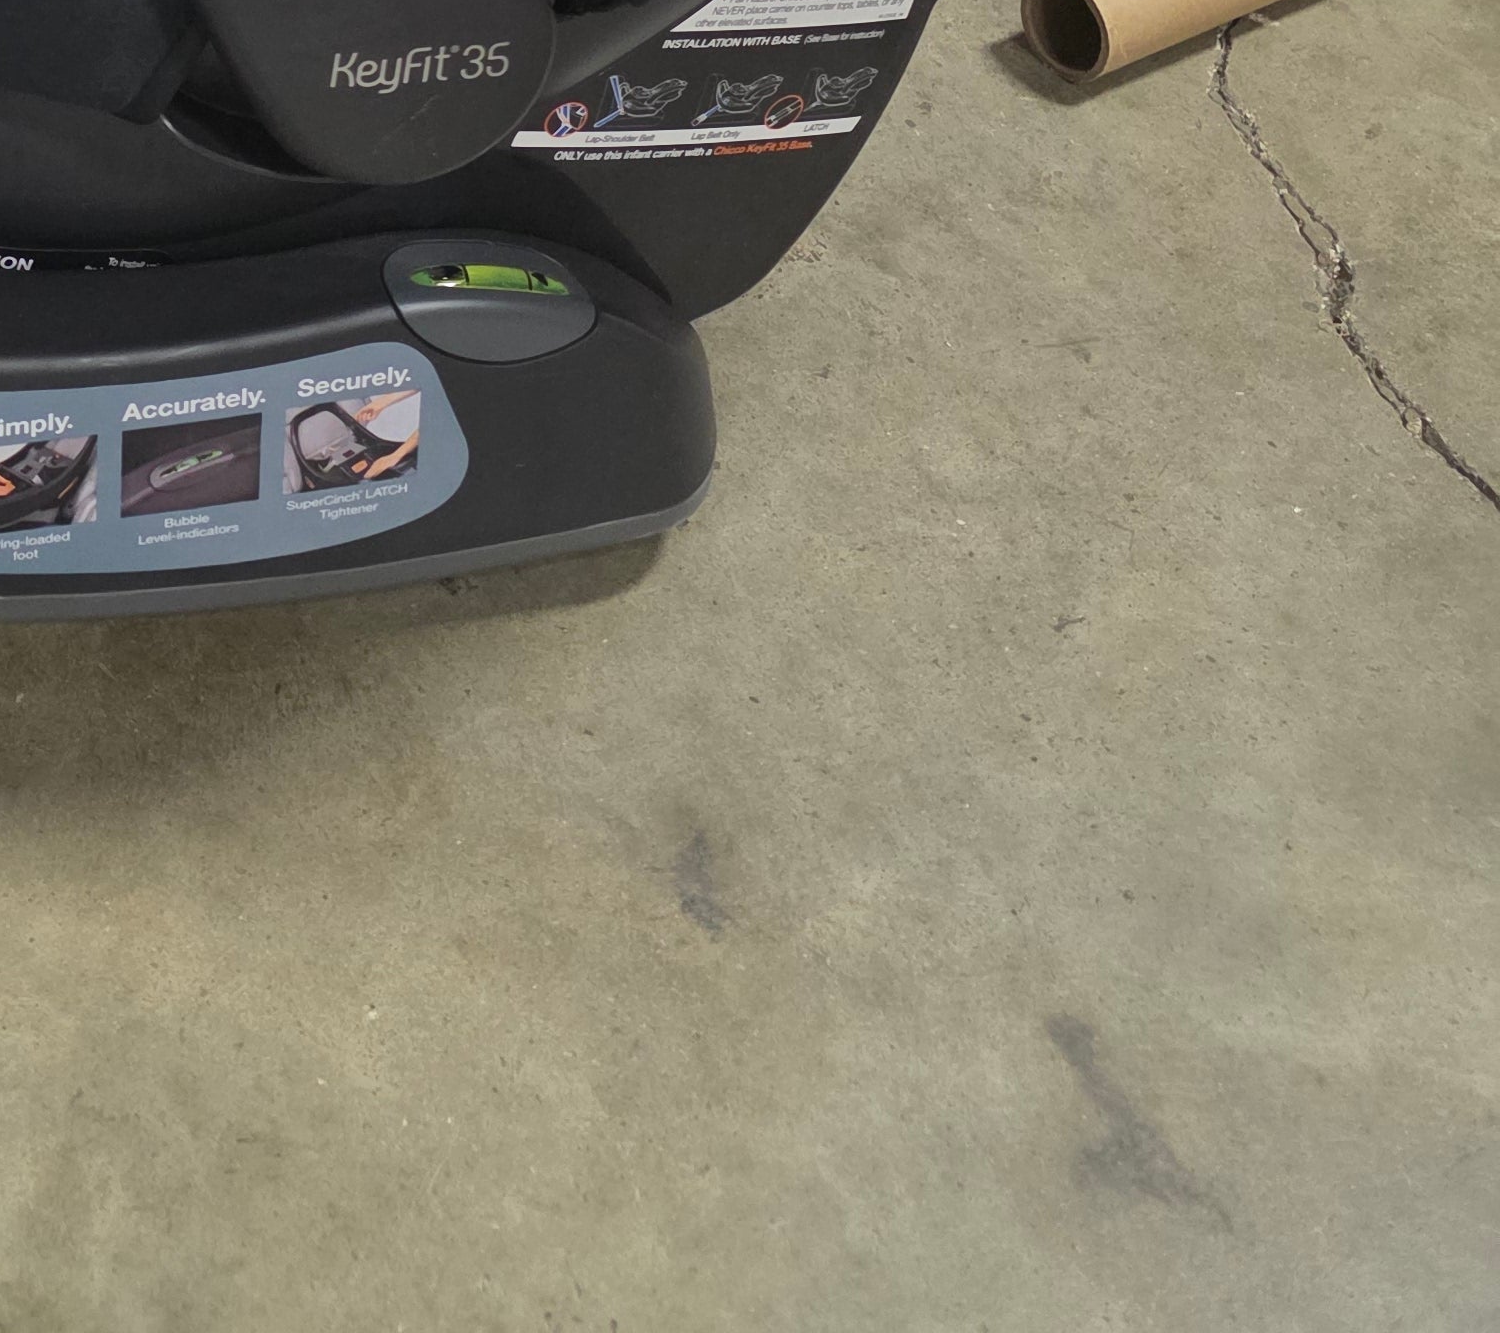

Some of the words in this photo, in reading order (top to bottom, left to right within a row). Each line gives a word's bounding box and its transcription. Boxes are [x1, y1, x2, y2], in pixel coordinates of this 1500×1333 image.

[712, 6, 745, 15] NEVER
[745, 5, 767, 16] place
[662, 37, 741, 49] INSTALLATION
[742, 35, 769, 47] WITH
[771, 34, 801, 45] BASE
[329, 46, 451, 94] KeyFit
[460, 41, 511, 80] 35
[690, 132, 704, 141] Lap
[724, 130, 741, 139] Only
[803, 123, 830, 132] LATCH
[585, 134, 639, 143] Lap-Shoulder
[639, 134, 656, 142] Belt
[554, 151, 584, 161] ONLY
[584, 152, 602, 160] use
[604, 150, 622, 160] this
[624, 150, 650, 160] infant
[652, 149, 683, 159] carrier
[684, 147, 704, 157] with
[714, 145, 747, 156] Chicco
[748, 143, 776, 154] KeyFit
[776, 141, 788, 151] 35
[789, 140, 813, 150] Base.
[297, 366, 411, 398] Securely.
[121, 387, 267, 423] Accurately.
[286, 490, 361, 512] SuperCinch
[364, 483, 408, 497] LATCH
[319, 502, 378, 521] Tightener
[164, 514, 210, 528] Bubble
[138, 522, 239, 546] Level-indicators
[13, 549, 39, 561] foot
